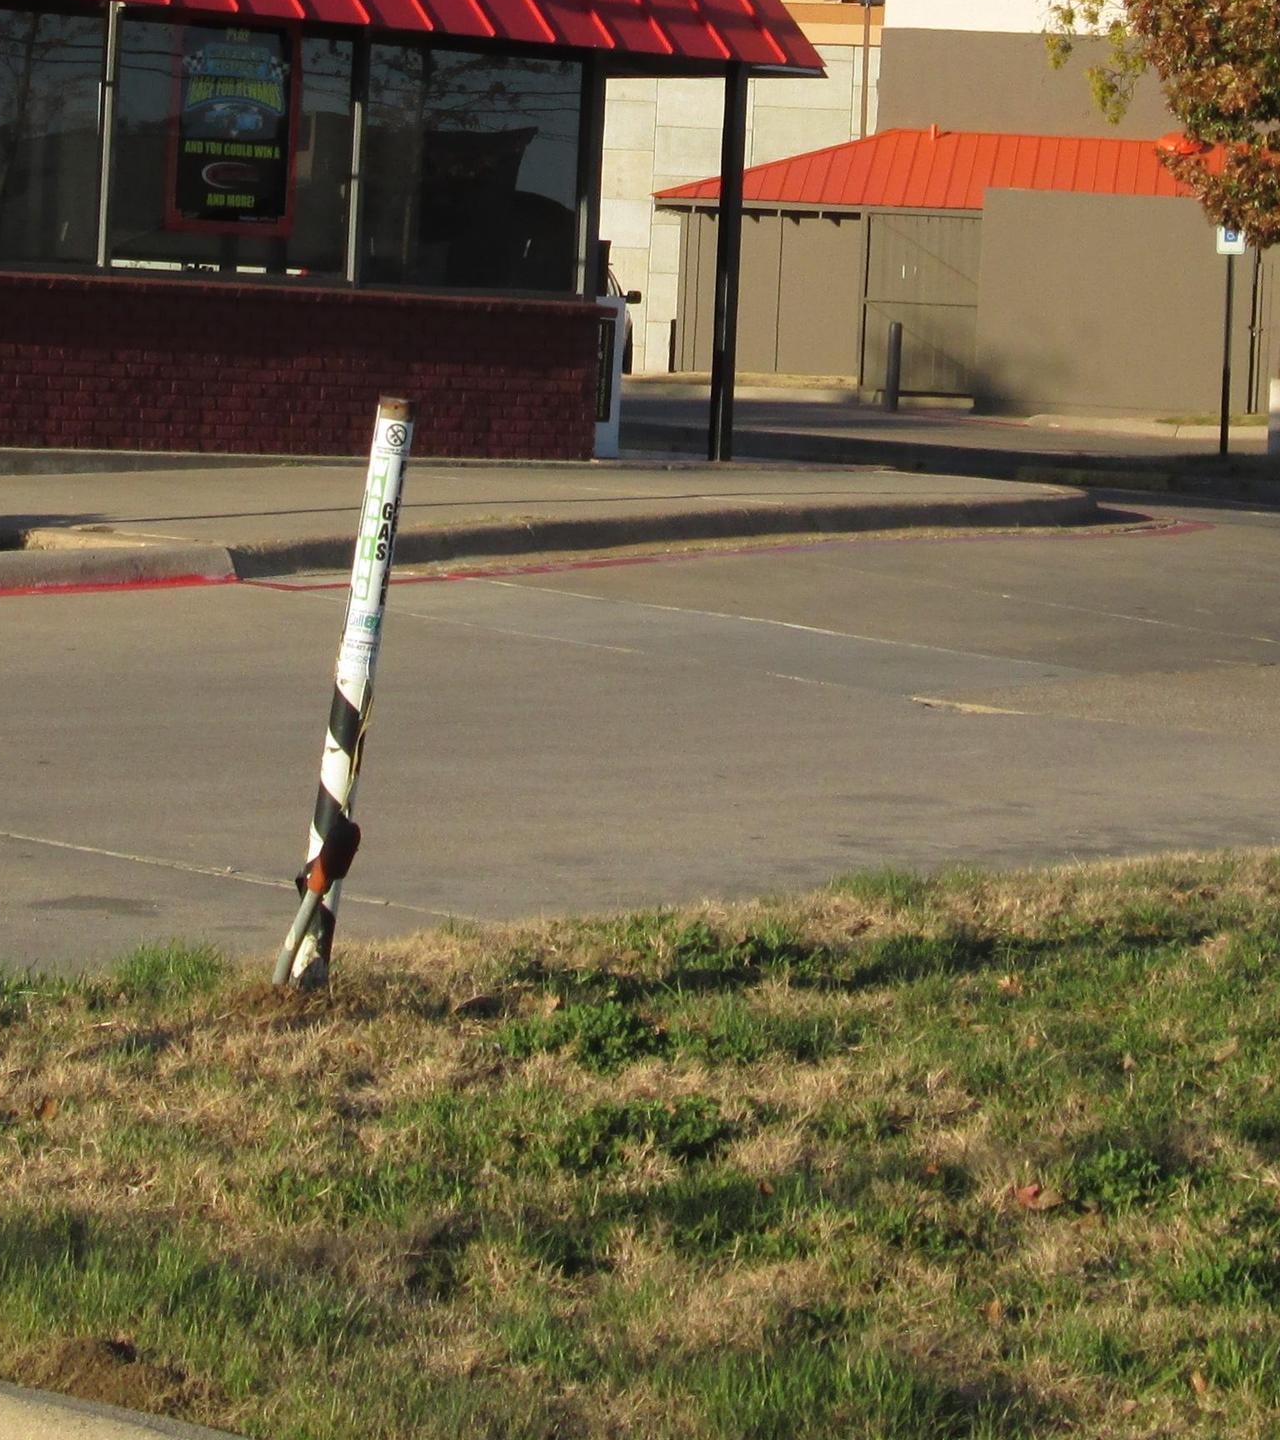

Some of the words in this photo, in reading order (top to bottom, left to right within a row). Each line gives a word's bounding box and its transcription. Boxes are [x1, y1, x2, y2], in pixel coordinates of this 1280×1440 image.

[184, 140, 204, 154] AND
[205, 141, 223, 155] YOU
[224, 143, 254, 157] COULD
[255, 145, 274, 159] WIN
[206, 193, 226, 207] AND
[375, 502, 394, 561] GAS
